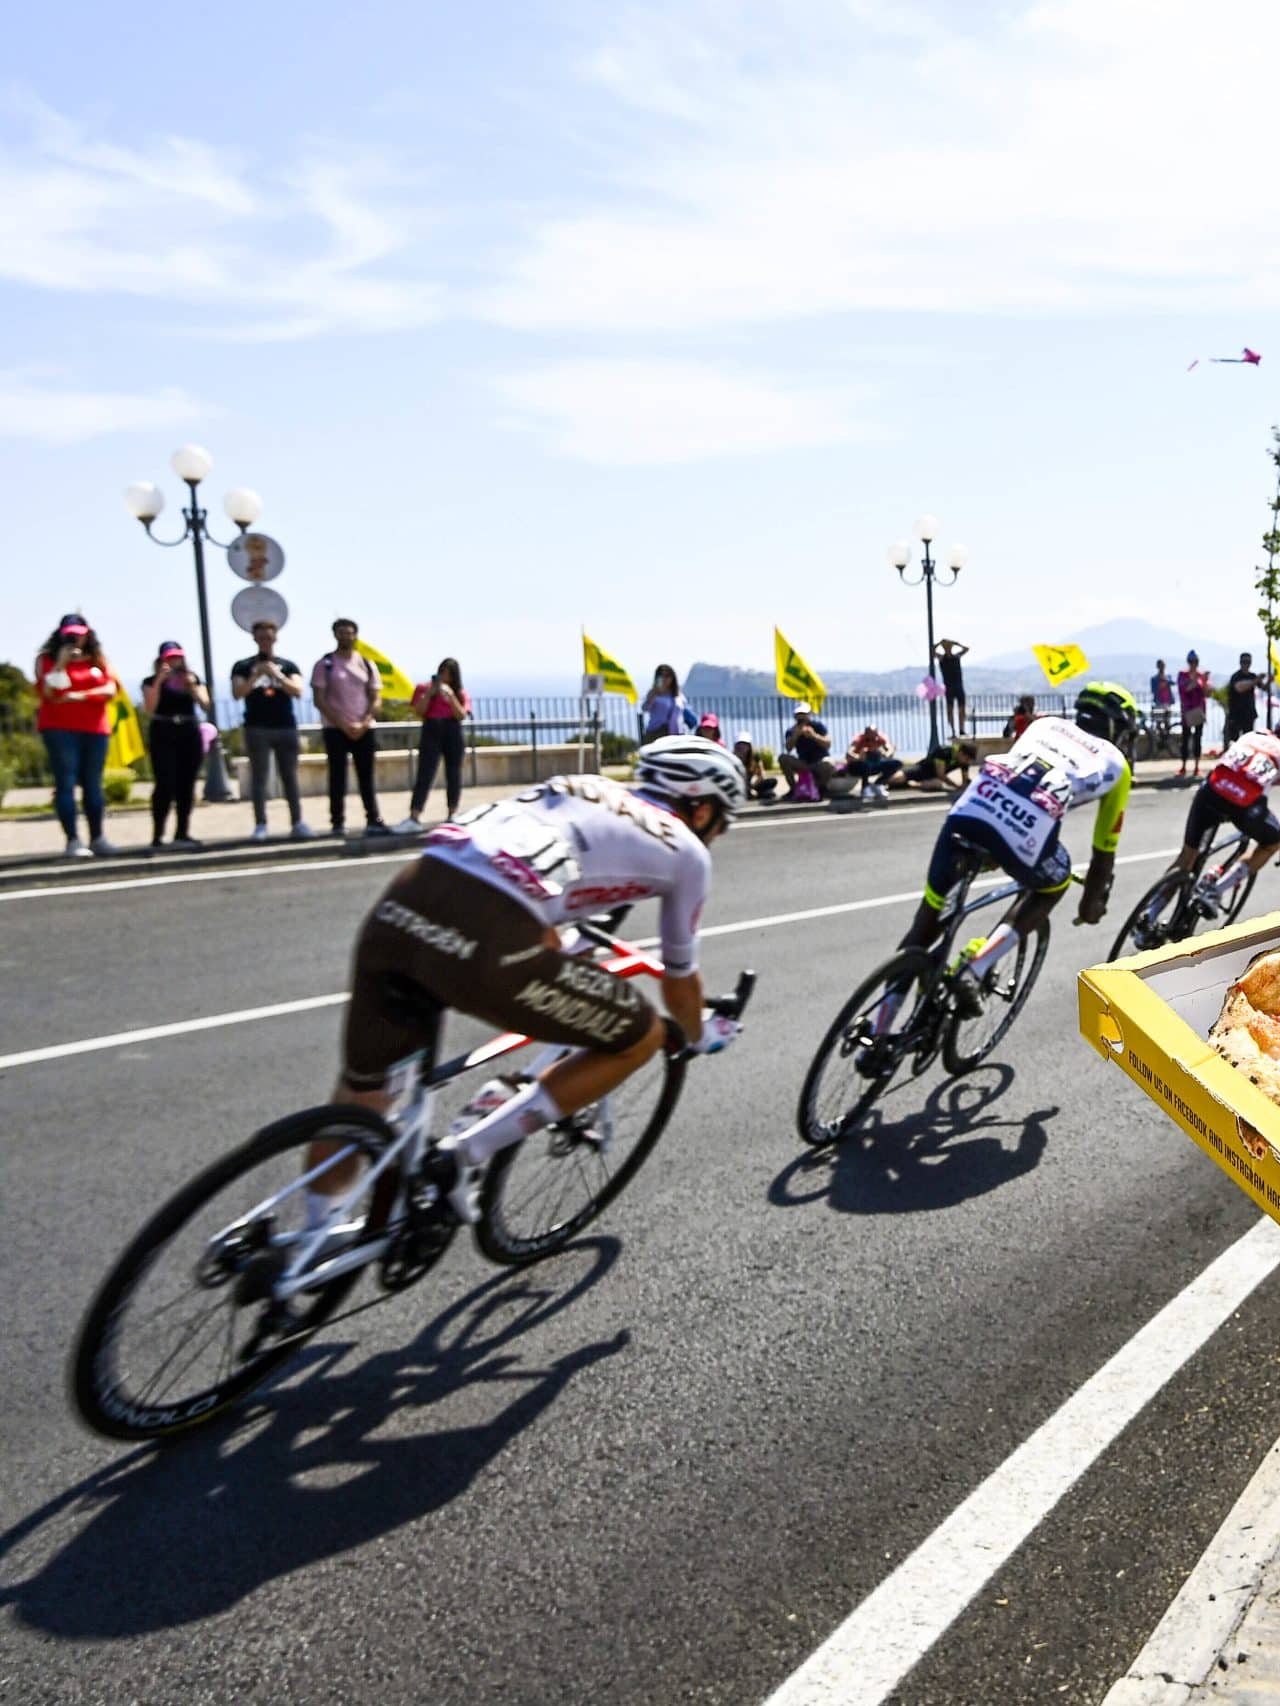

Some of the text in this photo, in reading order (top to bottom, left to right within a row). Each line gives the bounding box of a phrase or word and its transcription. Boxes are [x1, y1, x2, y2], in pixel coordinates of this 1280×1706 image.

[977, 780, 1037, 829] Circus
[1128, 1050, 1153, 1084] FOLLOW
[1154, 1074, 1163, 1094] US
[1164, 1084, 1173, 1105] ON
[1174, 1094, 1208, 1140] FACEBOOK
[1209, 1128, 1223, 1153] AND
[1224, 1143, 1265, 1196] INSTAGRAM
